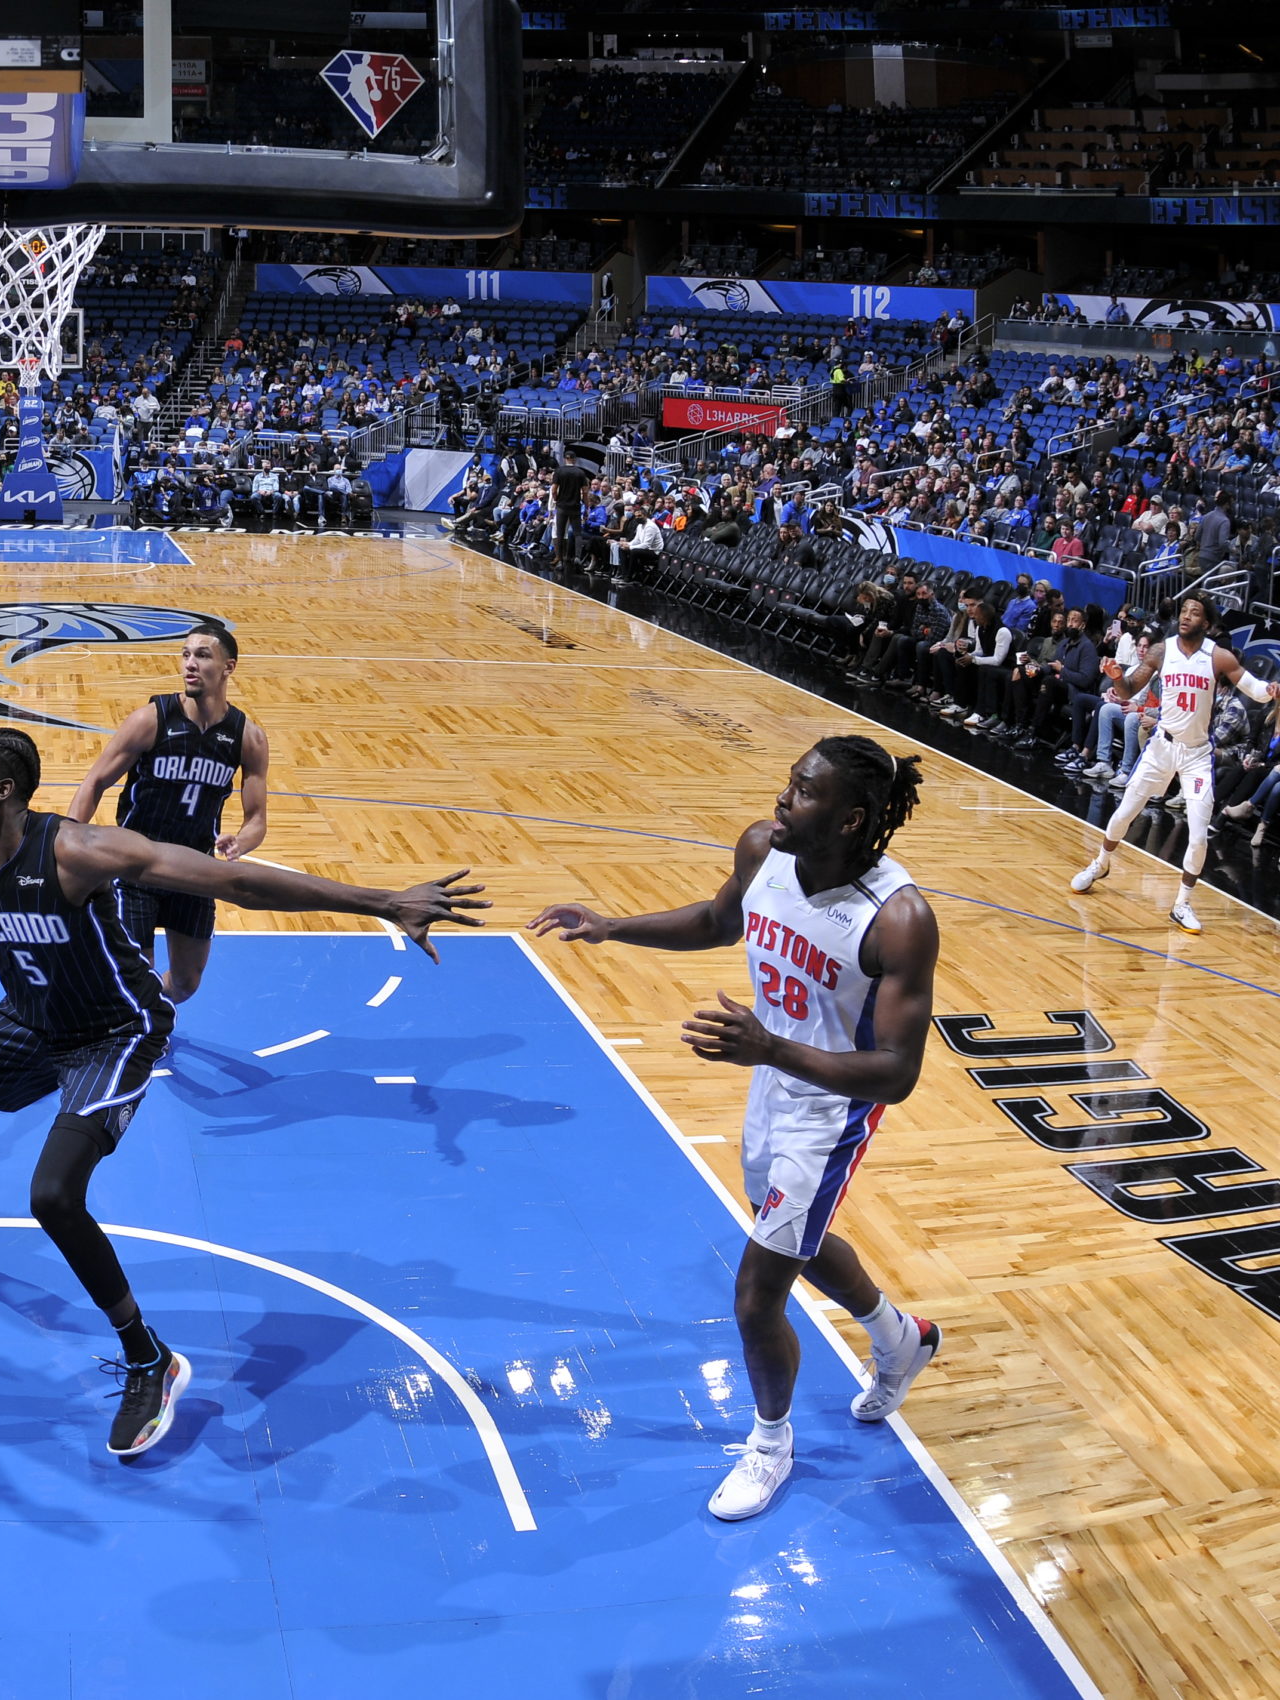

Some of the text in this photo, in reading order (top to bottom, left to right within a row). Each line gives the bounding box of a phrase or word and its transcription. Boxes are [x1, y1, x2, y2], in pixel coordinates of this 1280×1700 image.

[382, 66, 401, 91] 75
[465, 270, 499, 300] 111
[851, 286, 890, 320] 112
[706, 409, 759, 424] L3HARRIS
[4, 490, 56, 503] KIA
[269, 529, 435, 540] MAGIC
[1164, 673, 1210, 691] PISTONS
[1177, 692, 1197, 712] 41
[153, 755, 236, 787] ORLANDO
[181, 783, 202, 816] 4
[16, 875, 45, 887] Disney
[827, 906, 853, 927] UWM
[746, 912, 842, 991] PISTONS
[12, 950, 49, 986] 5
[759, 961, 809, 1022] 28
